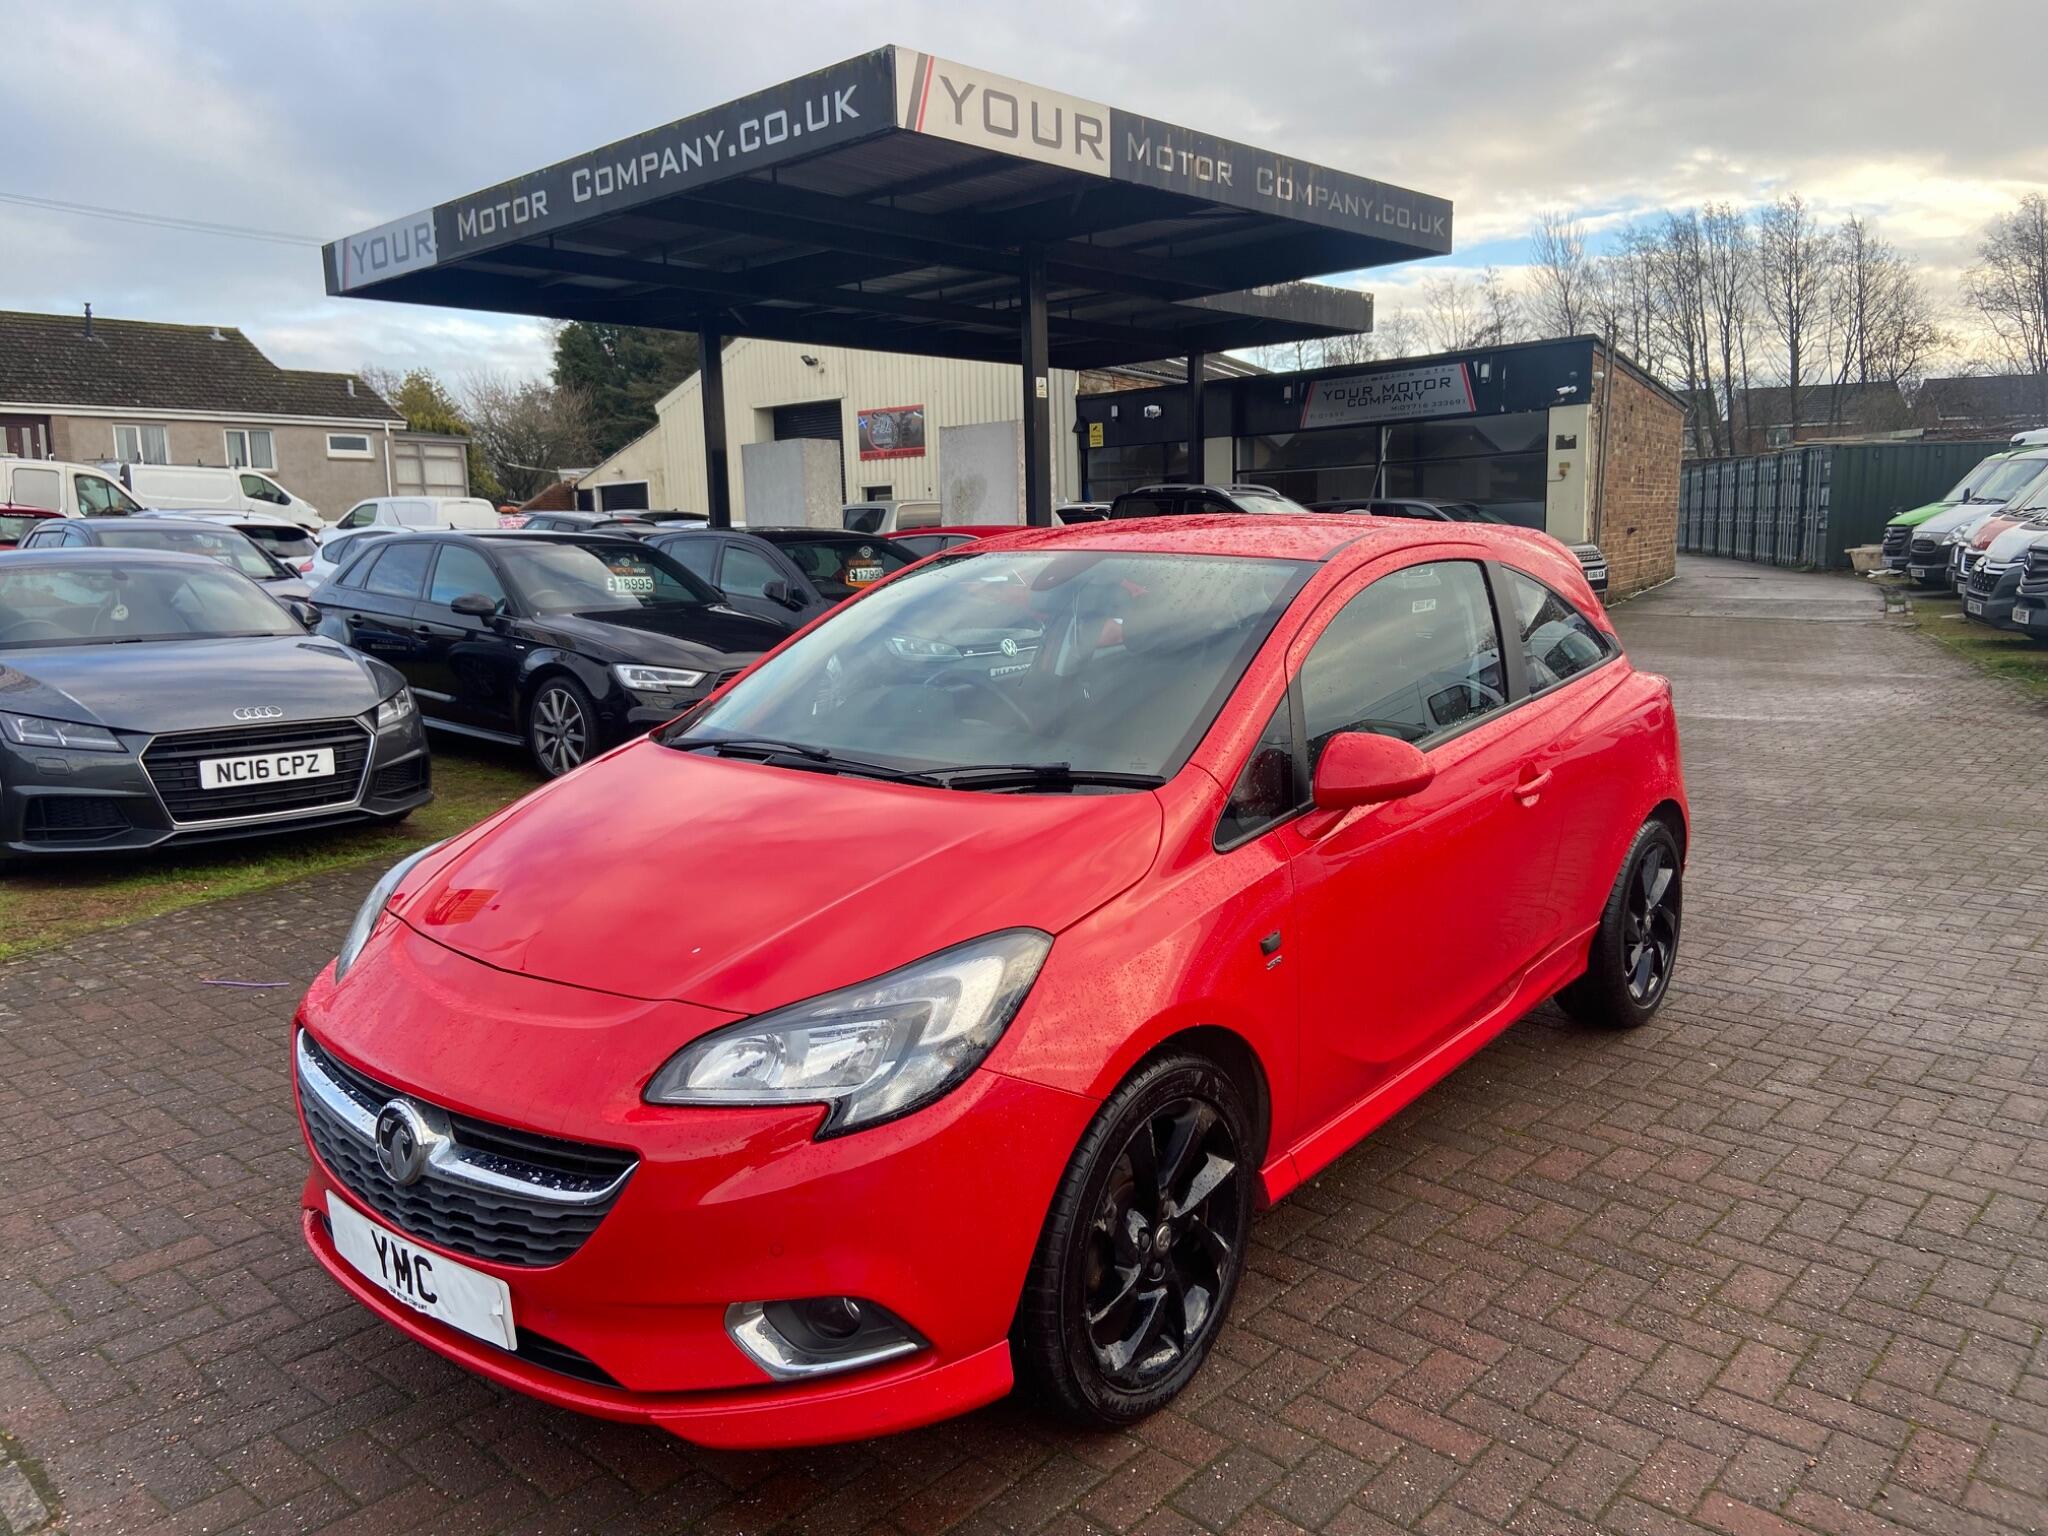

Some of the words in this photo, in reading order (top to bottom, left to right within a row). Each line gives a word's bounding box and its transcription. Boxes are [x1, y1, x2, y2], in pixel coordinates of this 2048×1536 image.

[351, 222, 434, 275] YOUR
[457, 190, 548, 241] MOTOR
[572, 84, 860, 202] COMPANY.CO.UK
[938, 75, 1104, 162] YOUR
[1127, 132, 1233, 187] MOTOR
[1256, 167, 1445, 237] COMPANY.CO.UK
[1323, 386, 1373, 400] YOUR
[1382, 377, 1451, 394] MOTOR
[1347, 391, 1425, 408] COMPANY
[216, 759, 270, 783] NC16
[276, 753, 320, 777] CPZ
[371, 1228, 438, 1305] YMC
